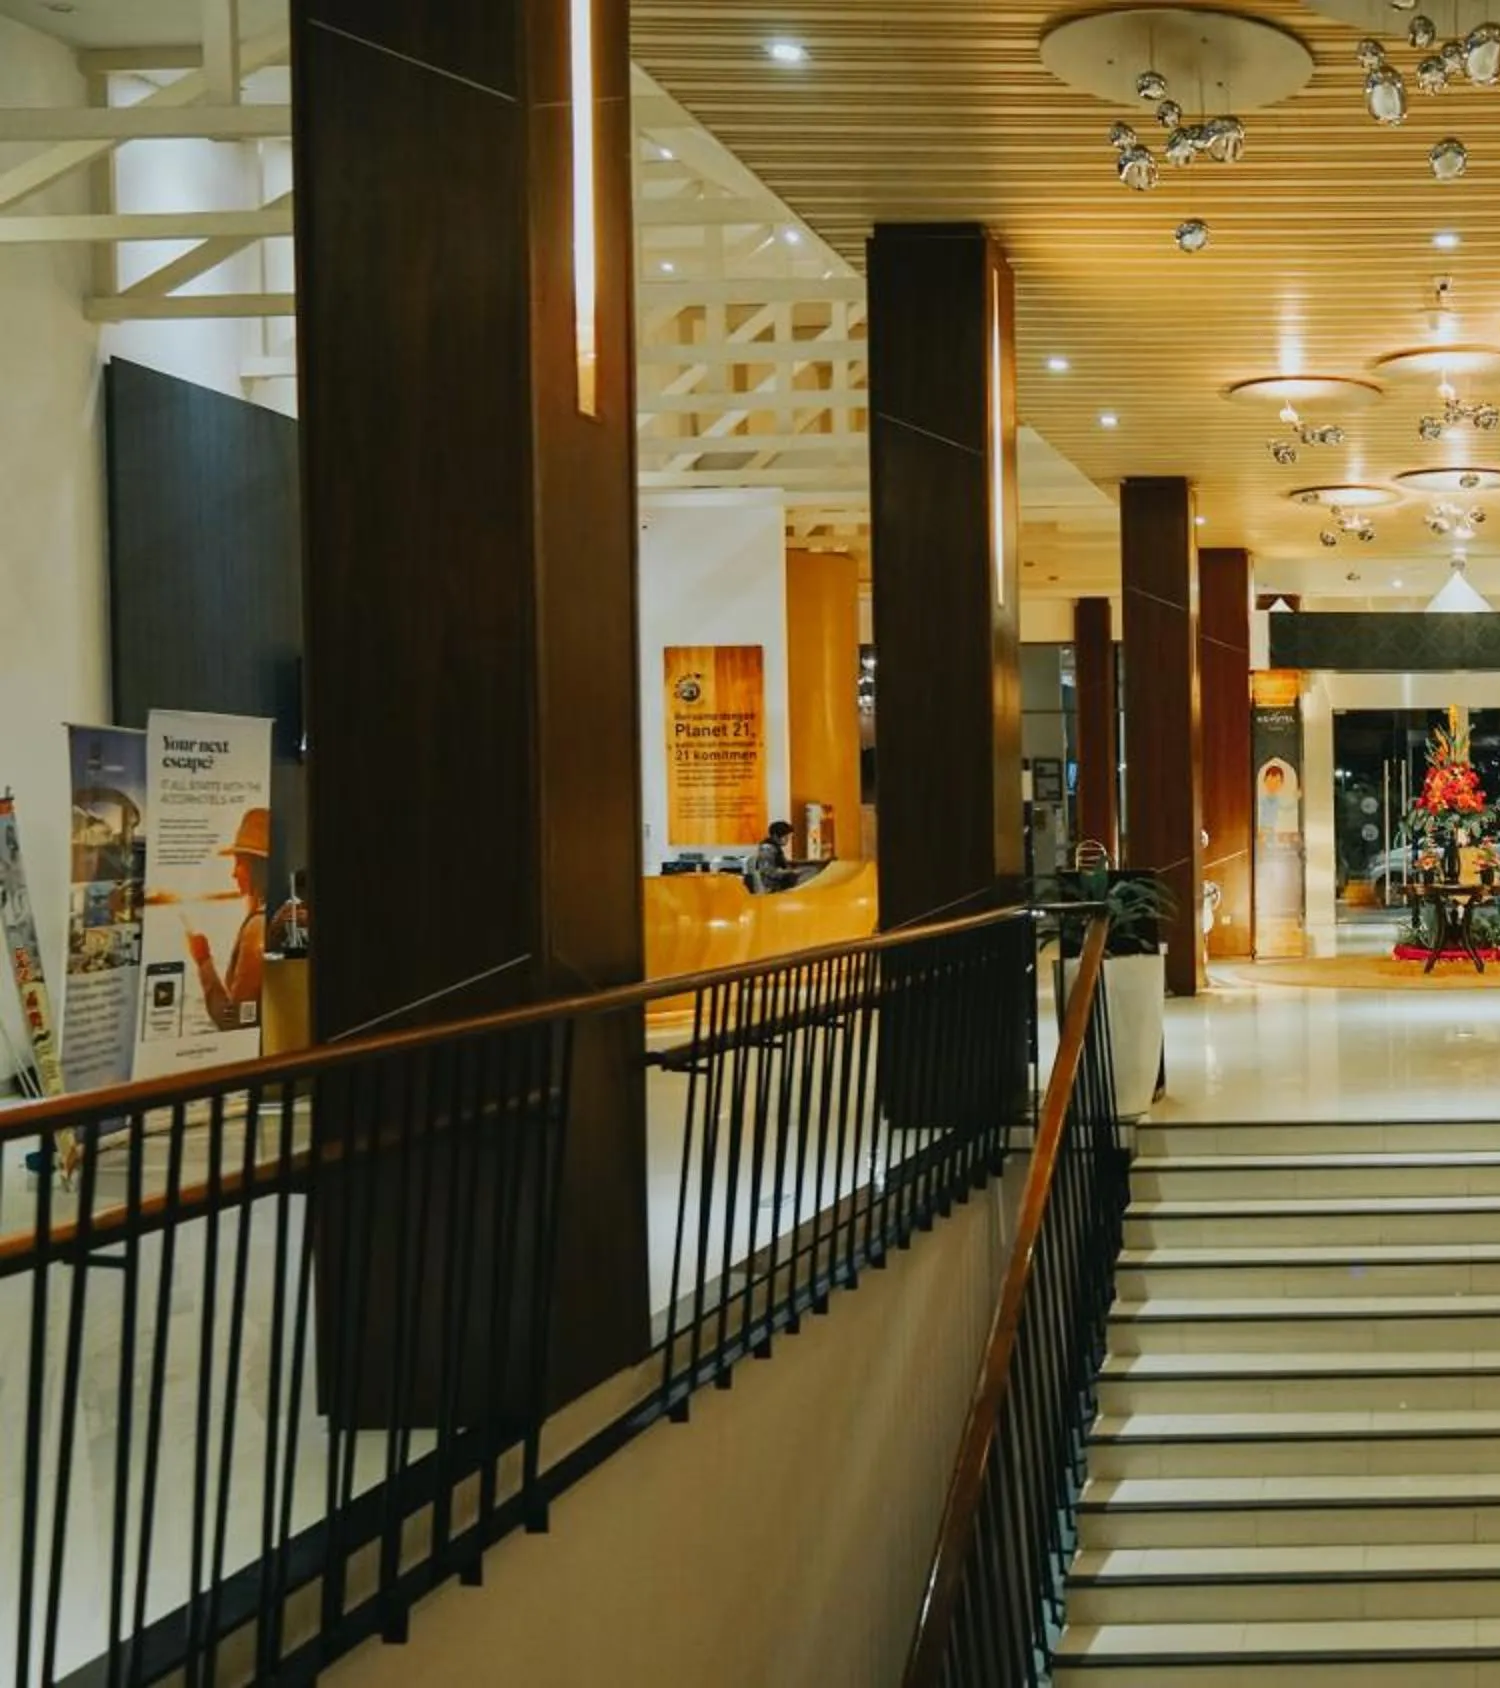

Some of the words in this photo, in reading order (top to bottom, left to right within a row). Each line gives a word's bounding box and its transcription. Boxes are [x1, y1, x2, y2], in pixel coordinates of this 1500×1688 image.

[675, 723, 728, 737] Planet
[163, 735, 198, 753] Your
[199, 740, 230, 754] next
[675, 749, 690, 761] 21
[162, 755, 215, 774] escape?
